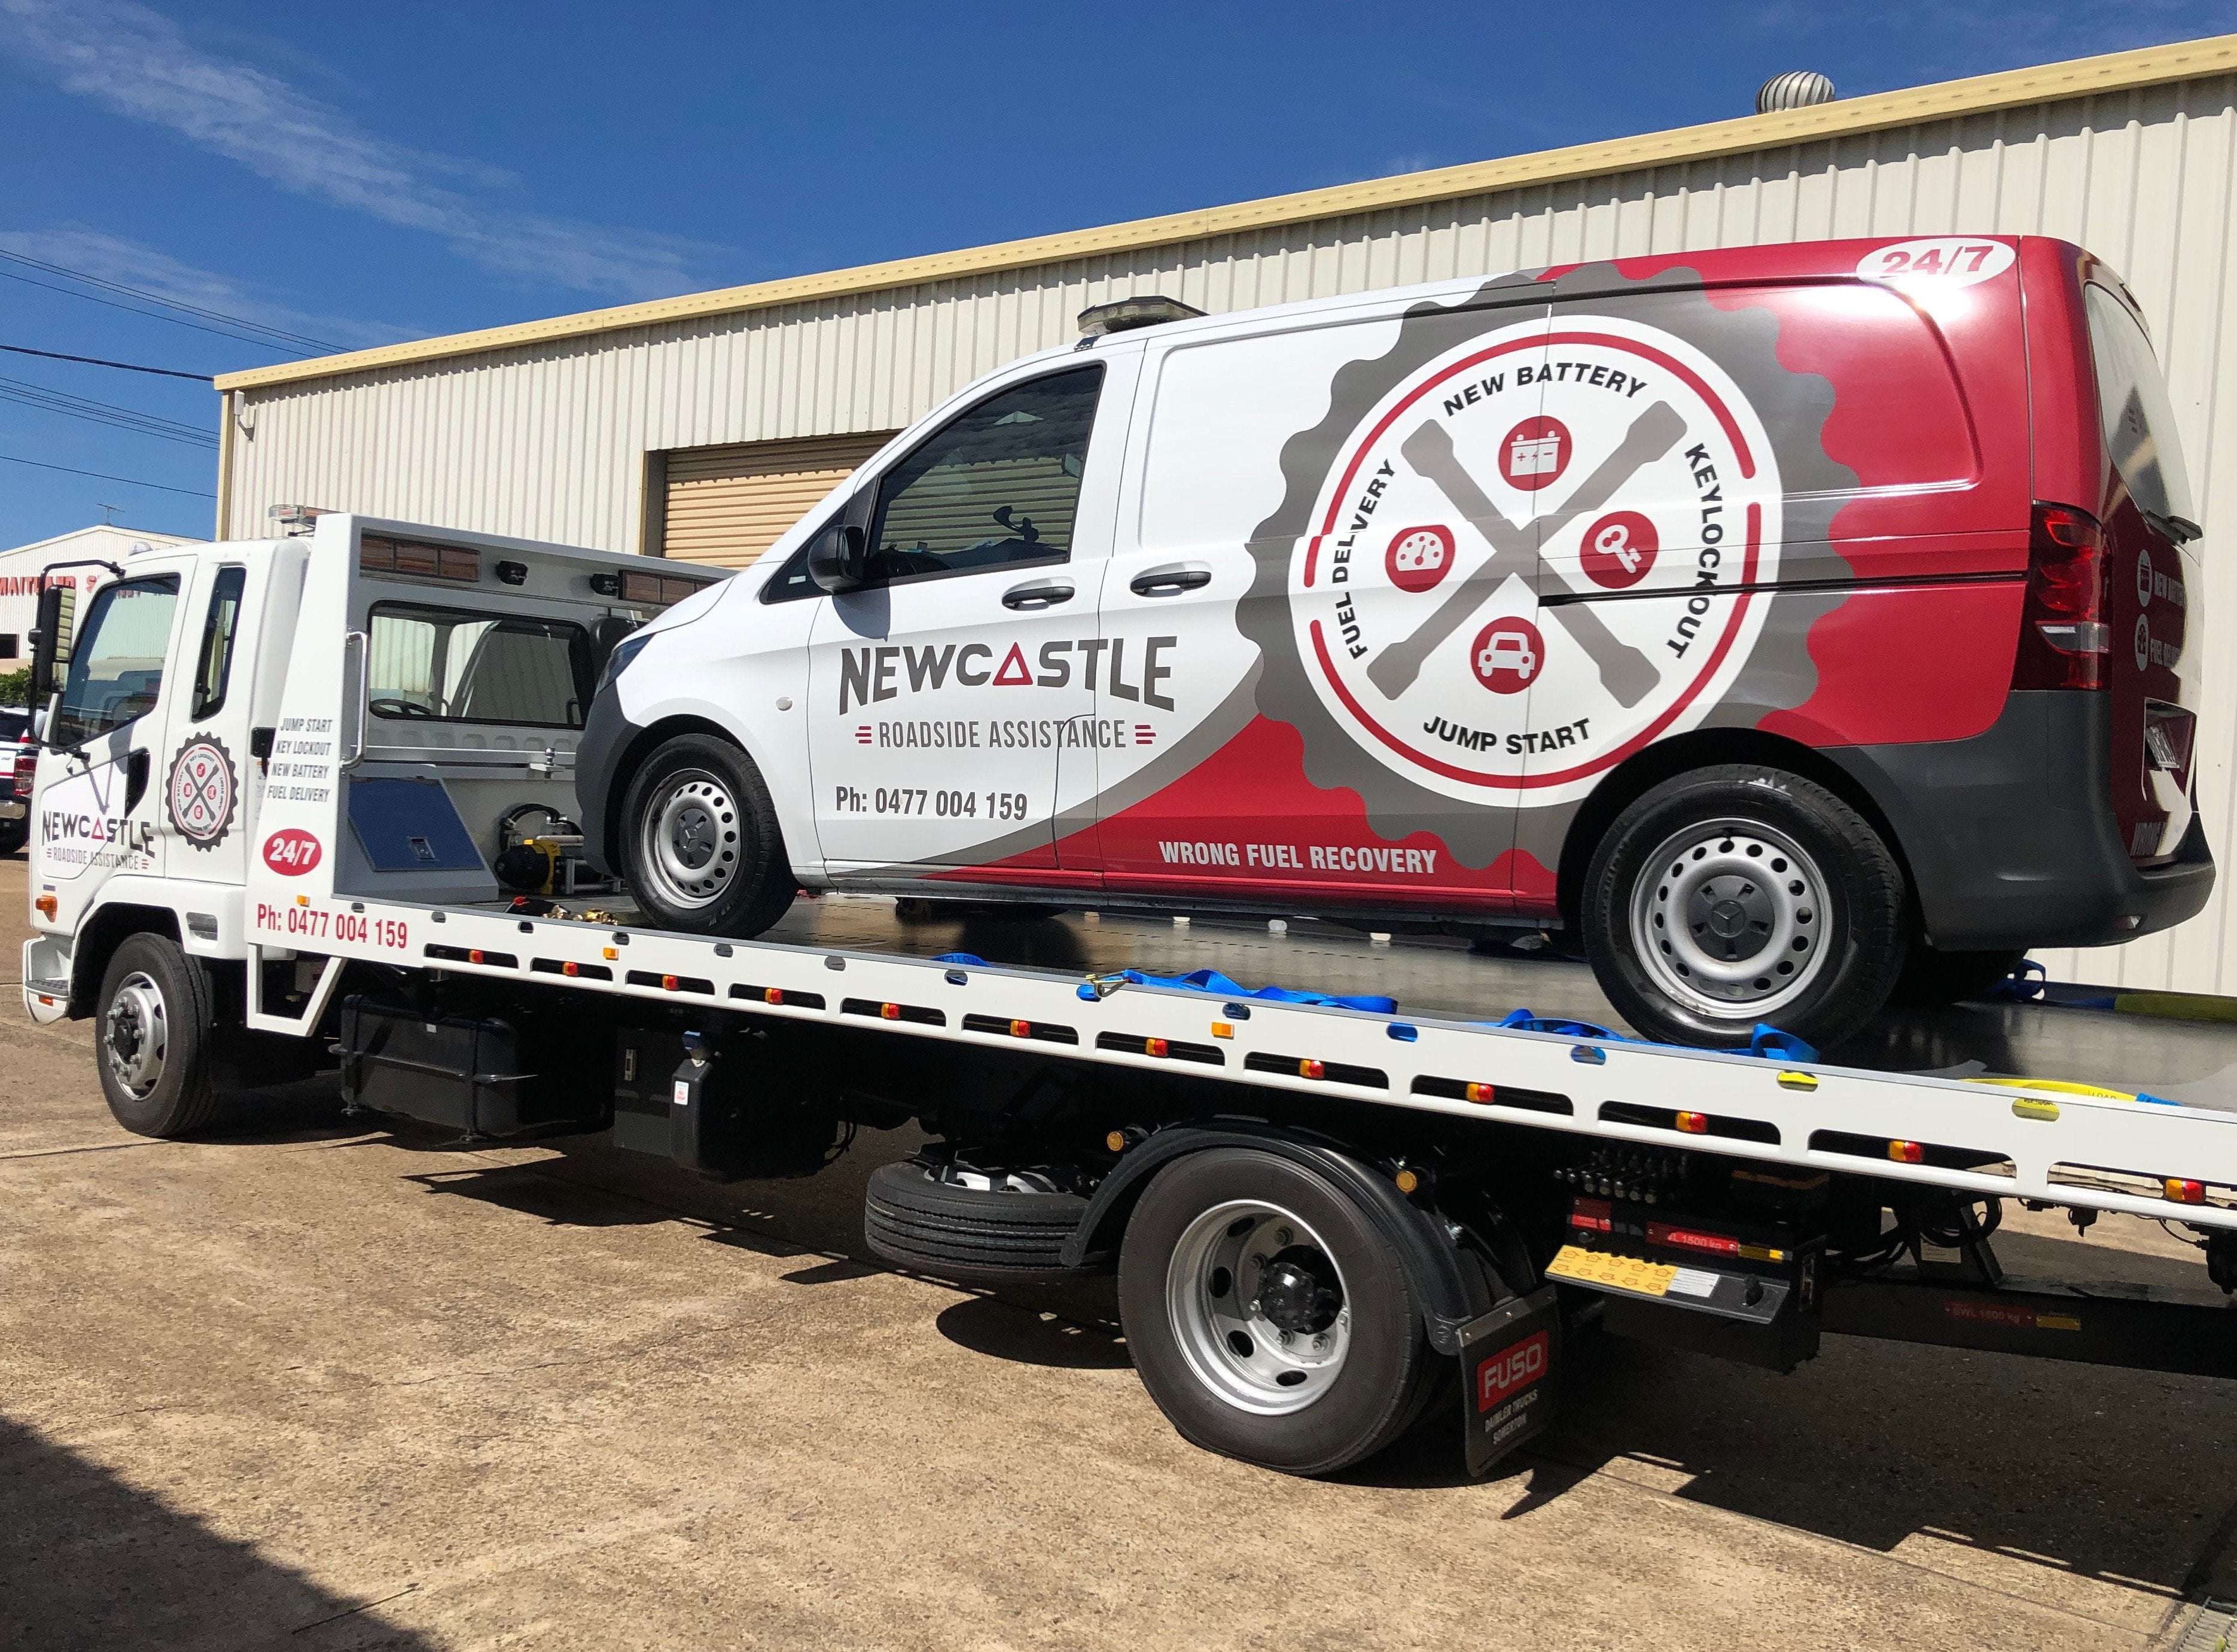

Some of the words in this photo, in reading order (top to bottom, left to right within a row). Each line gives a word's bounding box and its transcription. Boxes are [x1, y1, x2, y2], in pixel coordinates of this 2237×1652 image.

[1881, 246, 1994, 279] 24/7
[1443, 372, 1505, 417] NEW
[1516, 362, 1648, 399] BATTERY
[1331, 458, 1395, 584] DELIVERY
[1336, 591, 1369, 659] FUEL
[839, 635, 1178, 716] NEWCASTLE
[280, 718, 304, 731] JUMP
[306, 718, 333, 733] START
[879, 721, 980, 748] ROADSIDE
[989, 720, 1126, 749] ASSISTANCE
[1423, 715, 1497, 752] JUMP
[1506, 717, 1596, 755] START
[276, 740, 292, 754] KEY
[292, 740, 331, 755] LOCKOUT
[271, 763, 291, 777] NEW
[291, 764, 330, 779] BATTERY
[267, 785, 287, 799] FUEL
[289, 787, 331, 802] DELIVERY
[836, 786, 867, 812] Ph:
[875, 788, 928, 816] 0477
[935, 790, 976, 818] 004
[986, 792, 1028, 821] 159
[42, 810, 156, 859] NEWCASTLE
[270, 837, 316, 866] 24/7
[53, 847, 87, 865] ROADSIDE
[90, 851, 139, 870] ASSISTANCE
[1159, 841, 1239, 867] WRONG
[1246, 844, 1304, 868] FUEL
[1309, 846, 1437, 874] RECOVERY
[257, 903, 282, 931] Ph:
[288, 907, 330, 938] 0477
[336, 914, 368, 943] 004
[375, 919, 408, 949] 159
[1484, 1343, 1542, 1398] FUSO
